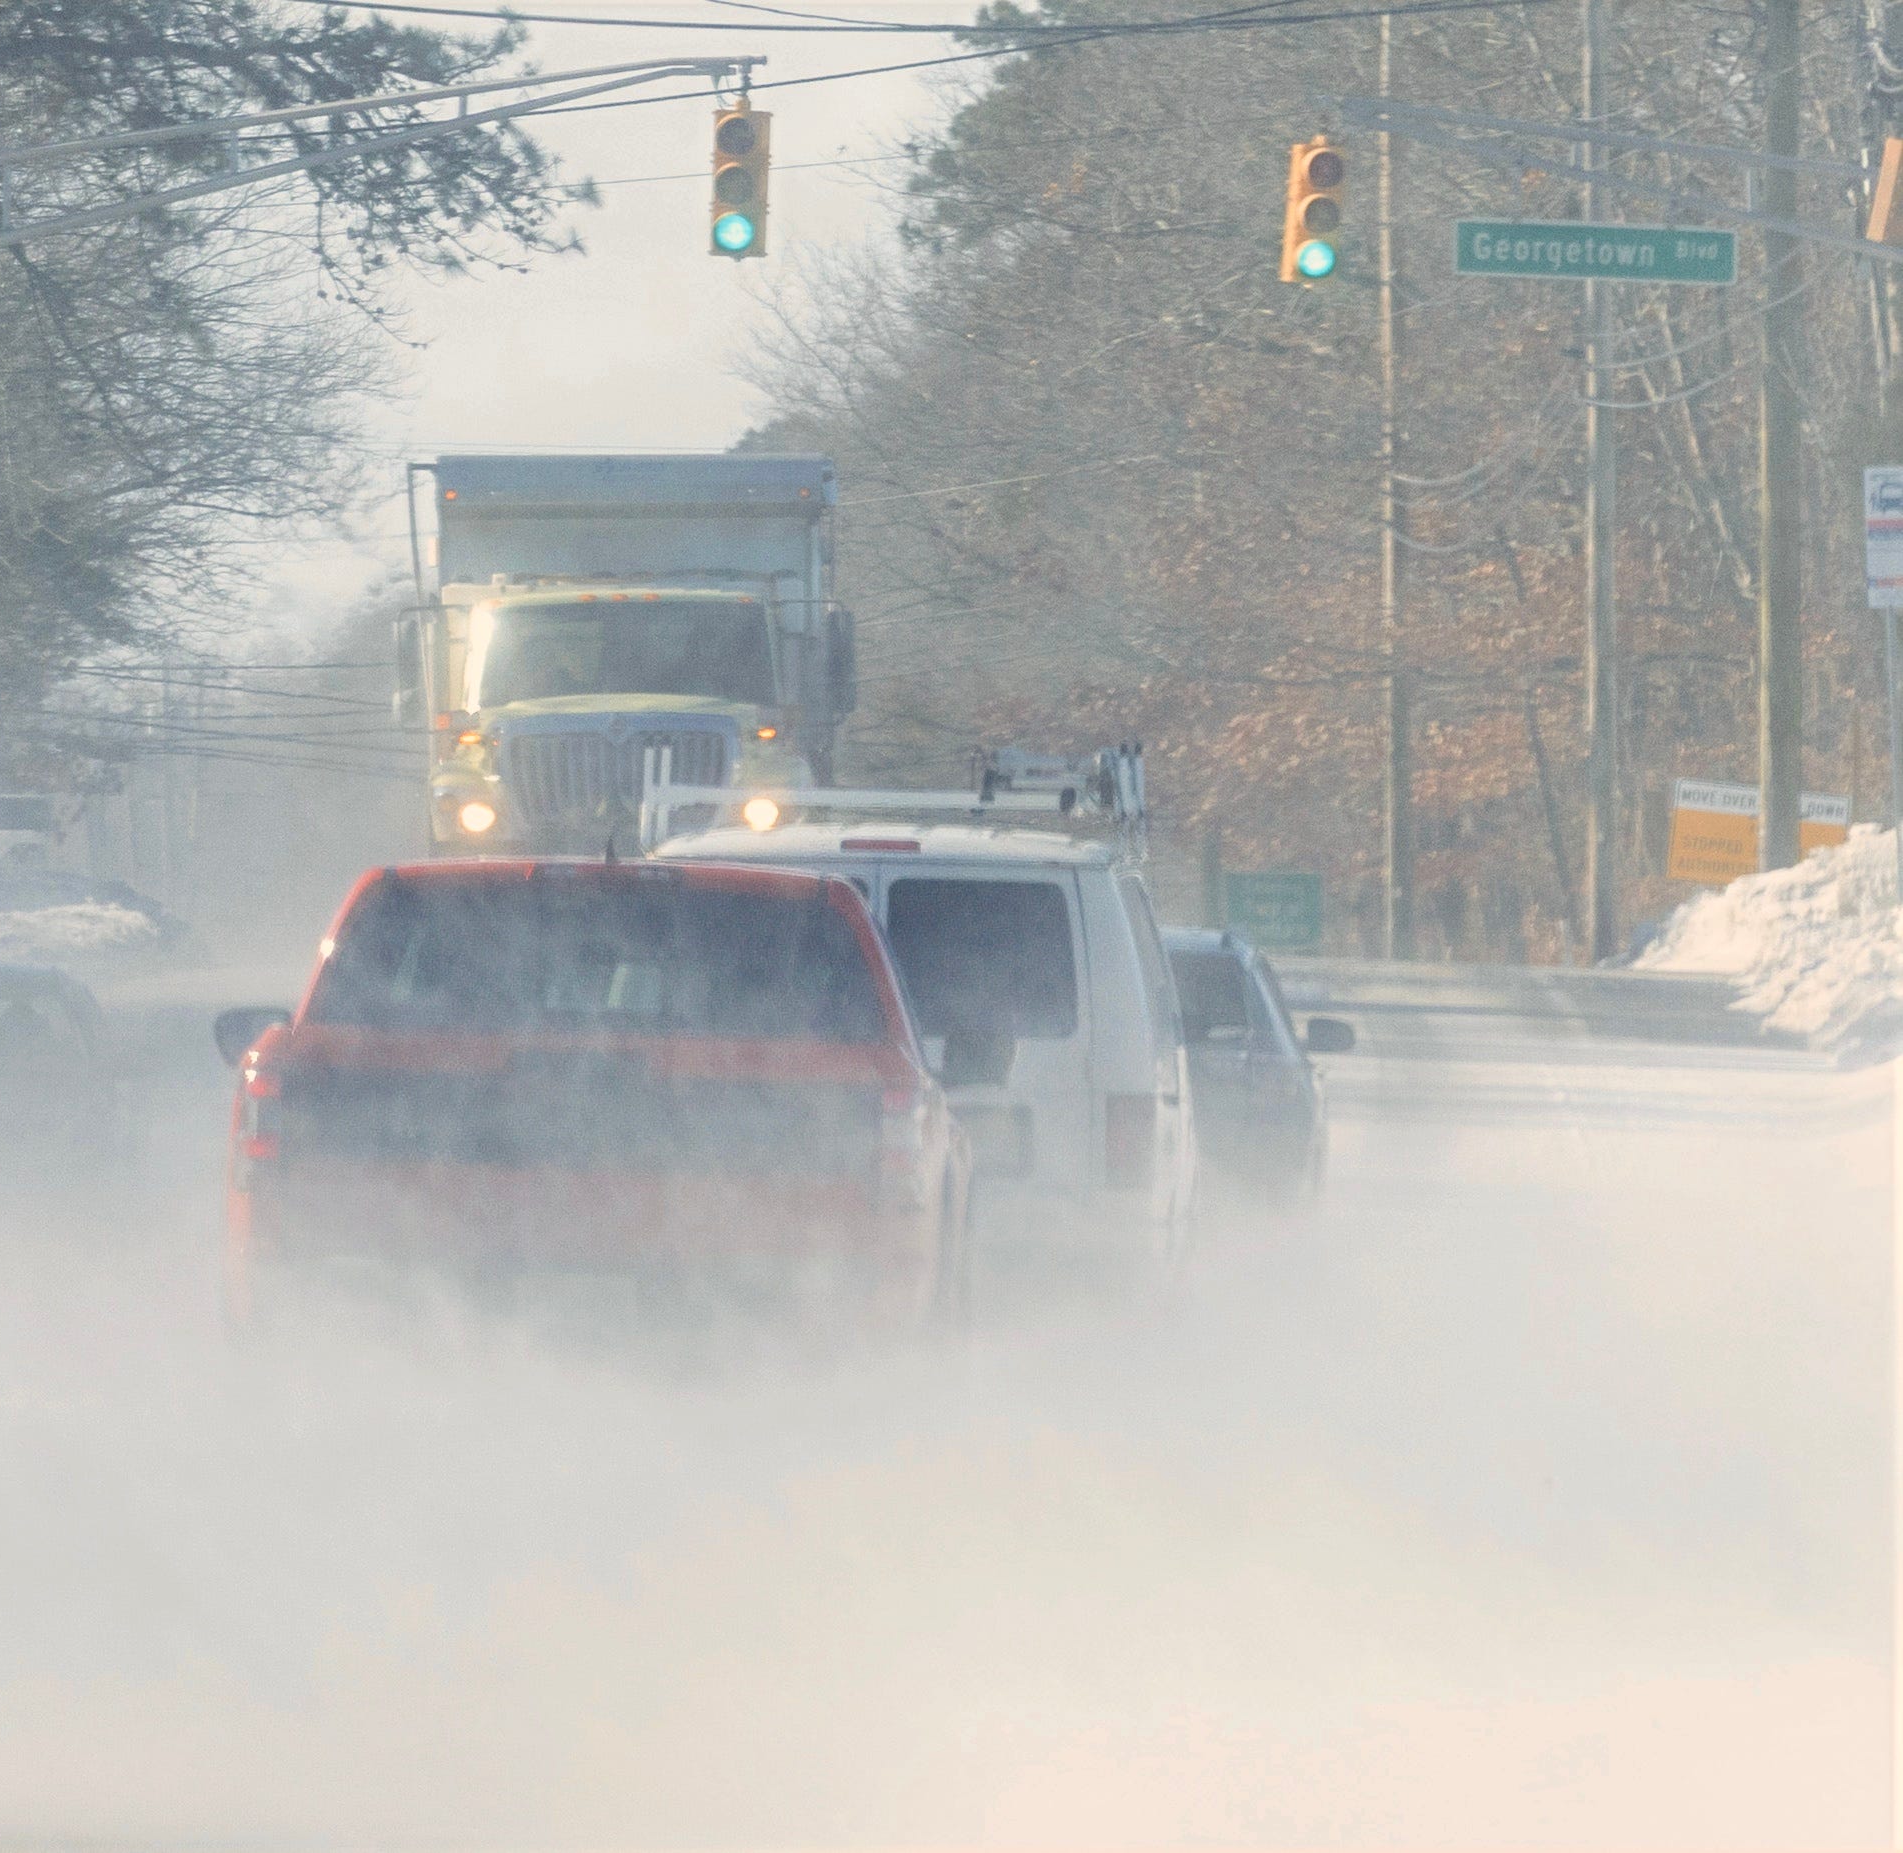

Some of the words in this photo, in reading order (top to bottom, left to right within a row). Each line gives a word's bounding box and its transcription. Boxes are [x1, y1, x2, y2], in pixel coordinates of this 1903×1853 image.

[1473, 232, 1654, 270] Georgetown
[1675, 240, 1717, 260] Blvd
[1681, 788, 1716, 807] MOVE
[1722, 793, 1757, 810] OVER
[1807, 801, 1845, 818] DOWN
